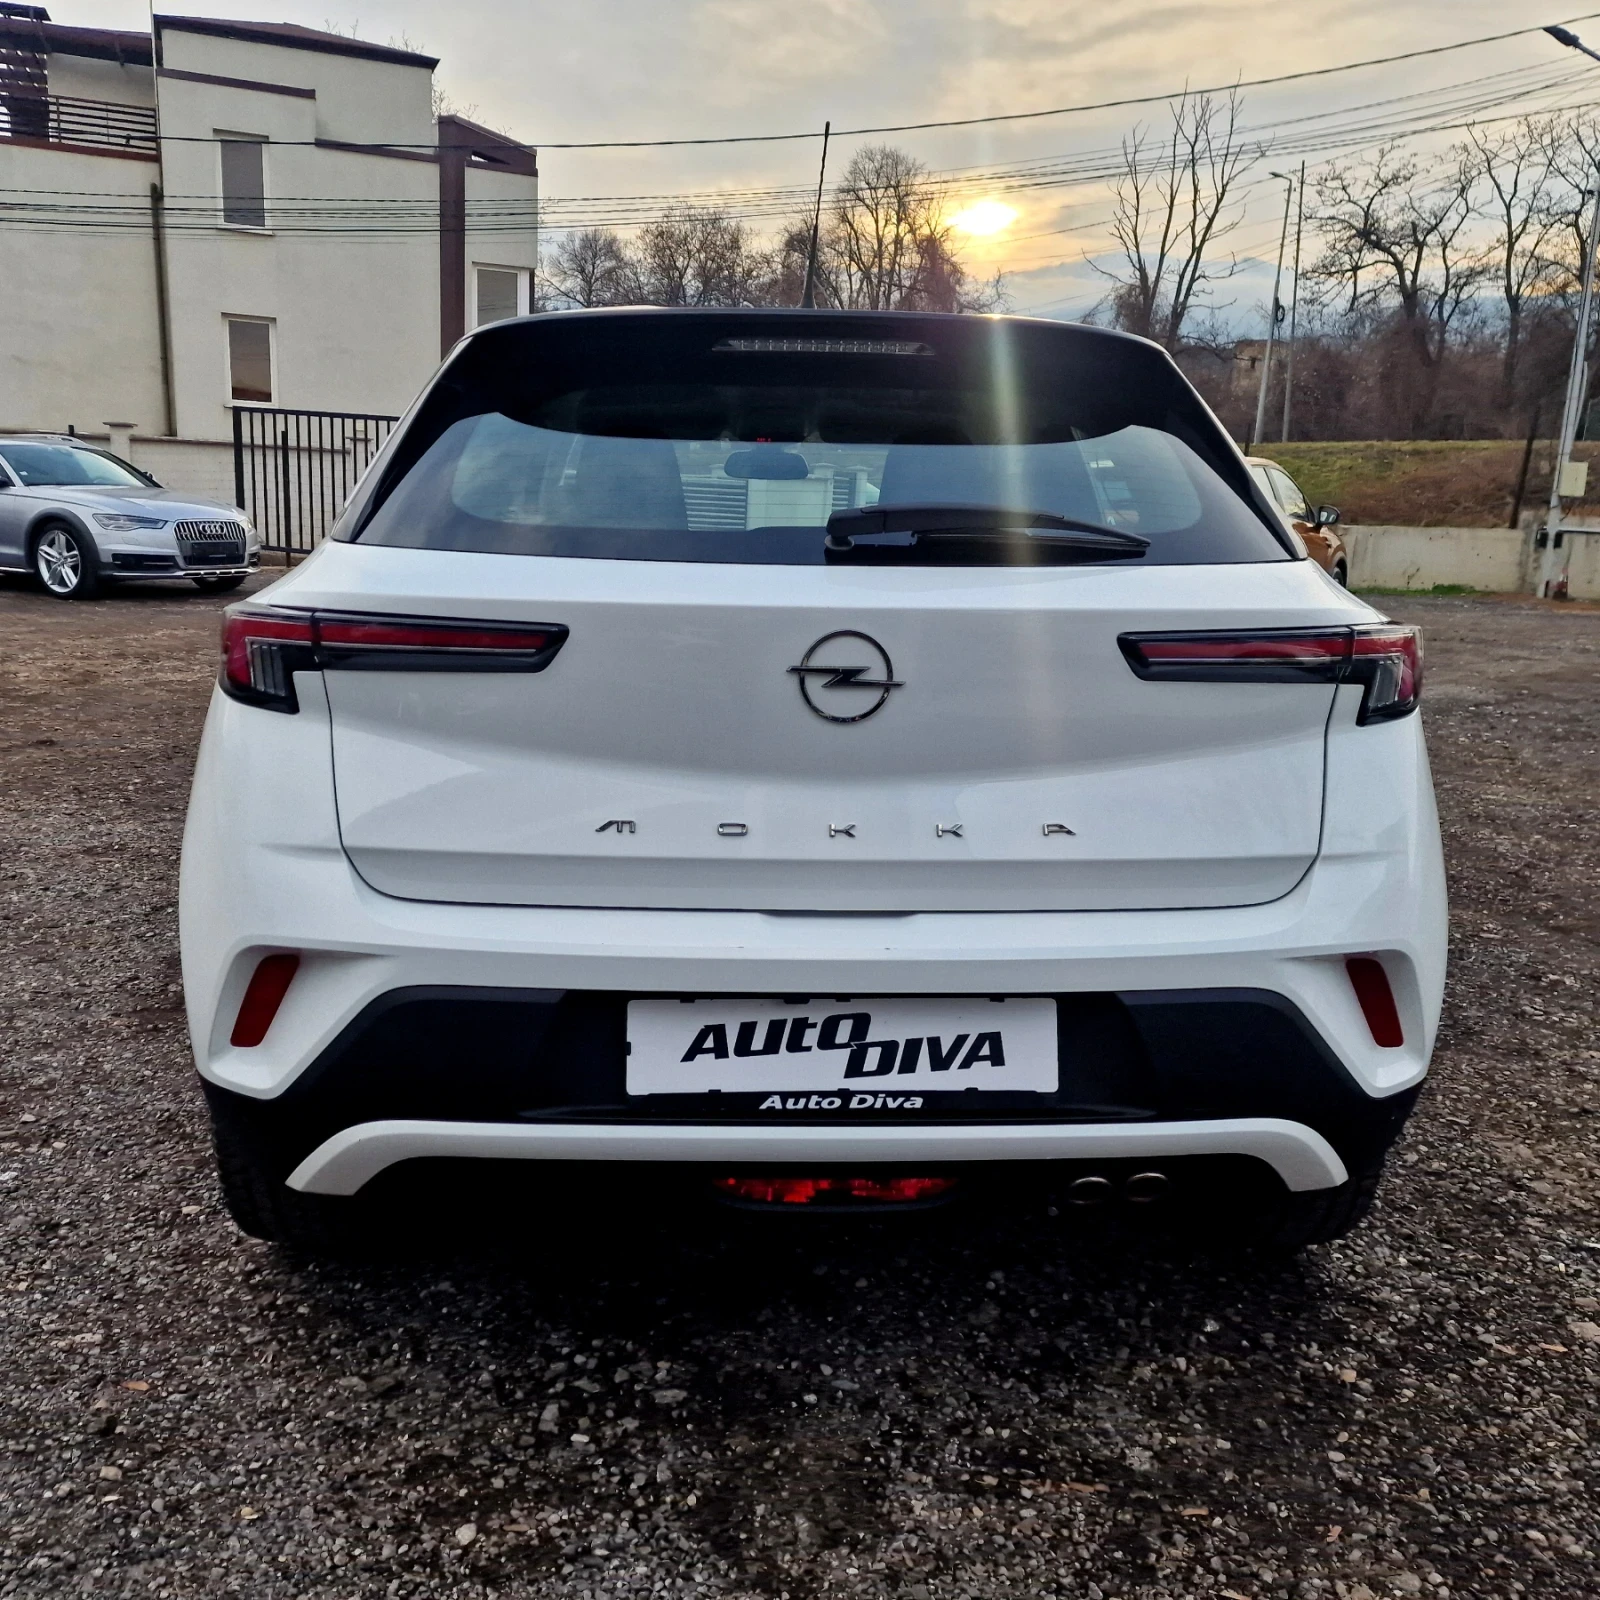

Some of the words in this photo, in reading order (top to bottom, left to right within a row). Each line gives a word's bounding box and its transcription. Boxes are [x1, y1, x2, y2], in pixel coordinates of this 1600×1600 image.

[595, 819, 1076, 838] MOKKA
[843, 1031, 1006, 1079] DIVA
[759, 1094, 842, 1110] Auto
[849, 1093, 924, 1110] Diva
